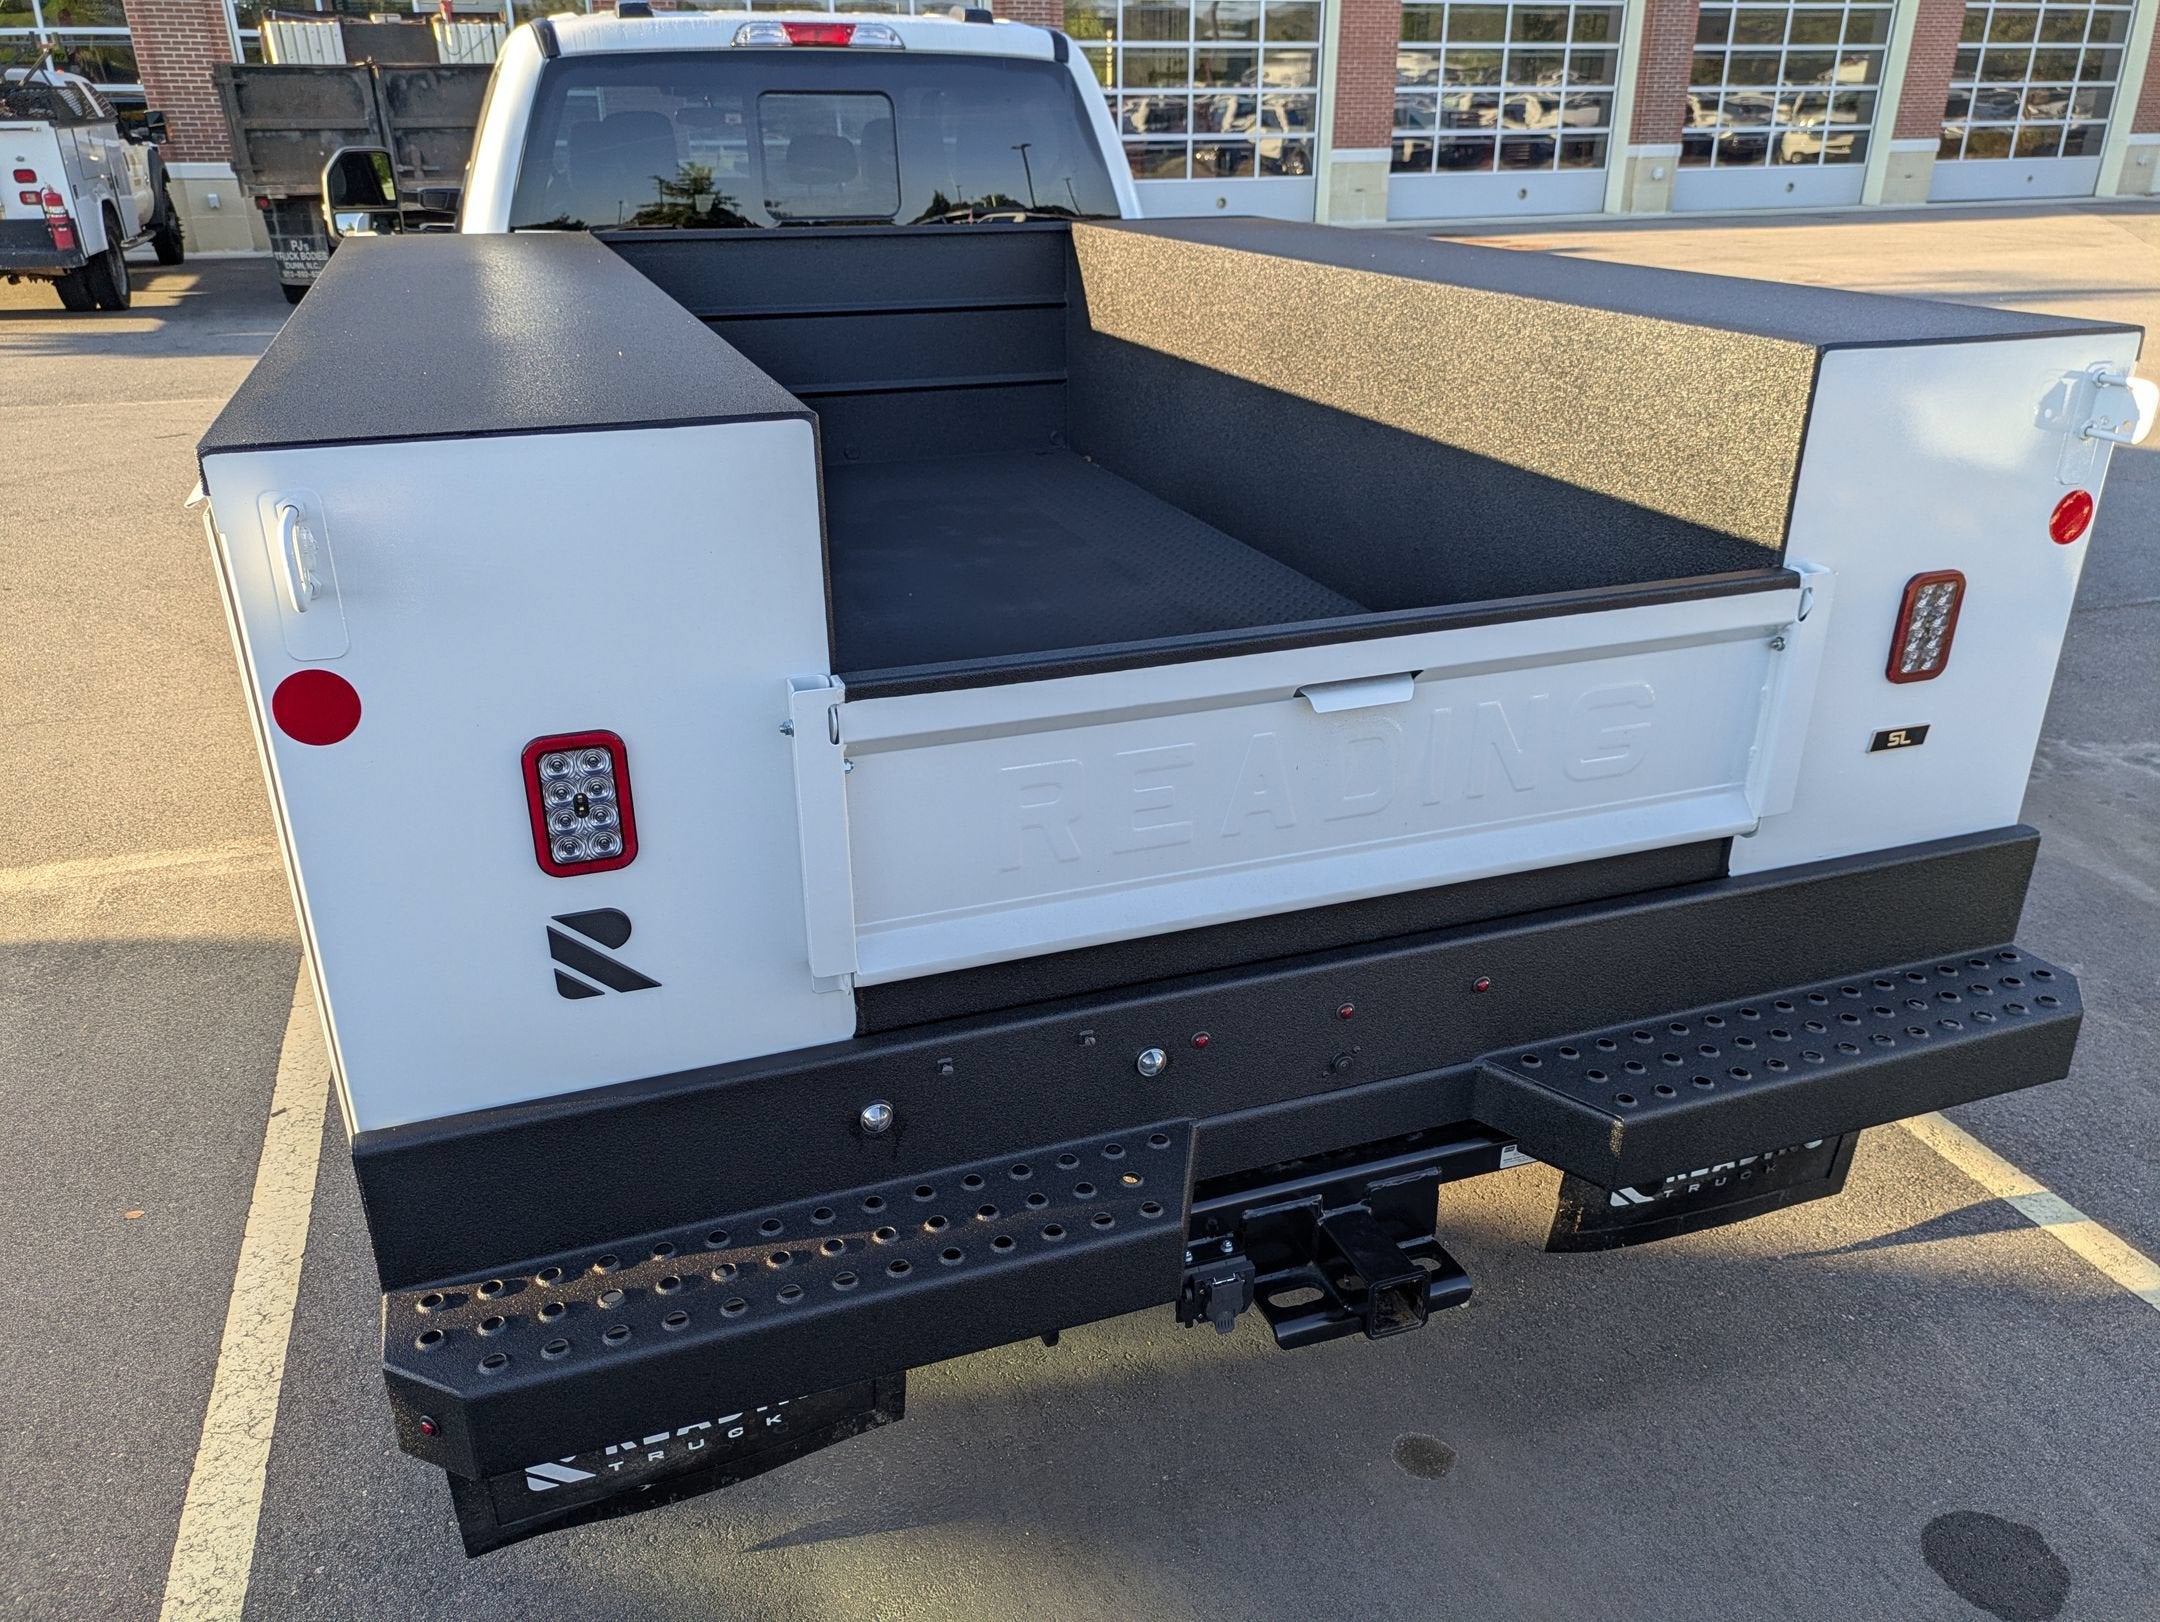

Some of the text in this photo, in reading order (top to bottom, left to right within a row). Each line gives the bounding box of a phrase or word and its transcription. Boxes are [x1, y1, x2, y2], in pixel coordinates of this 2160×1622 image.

[274, 251, 300, 261] TRUCK
[1887, 730, 1911, 747] SL
[1000, 681, 1656, 873] READING
[1663, 1163, 1777, 1199] TRUCK
[607, 1413, 782, 1472] TRUCK
